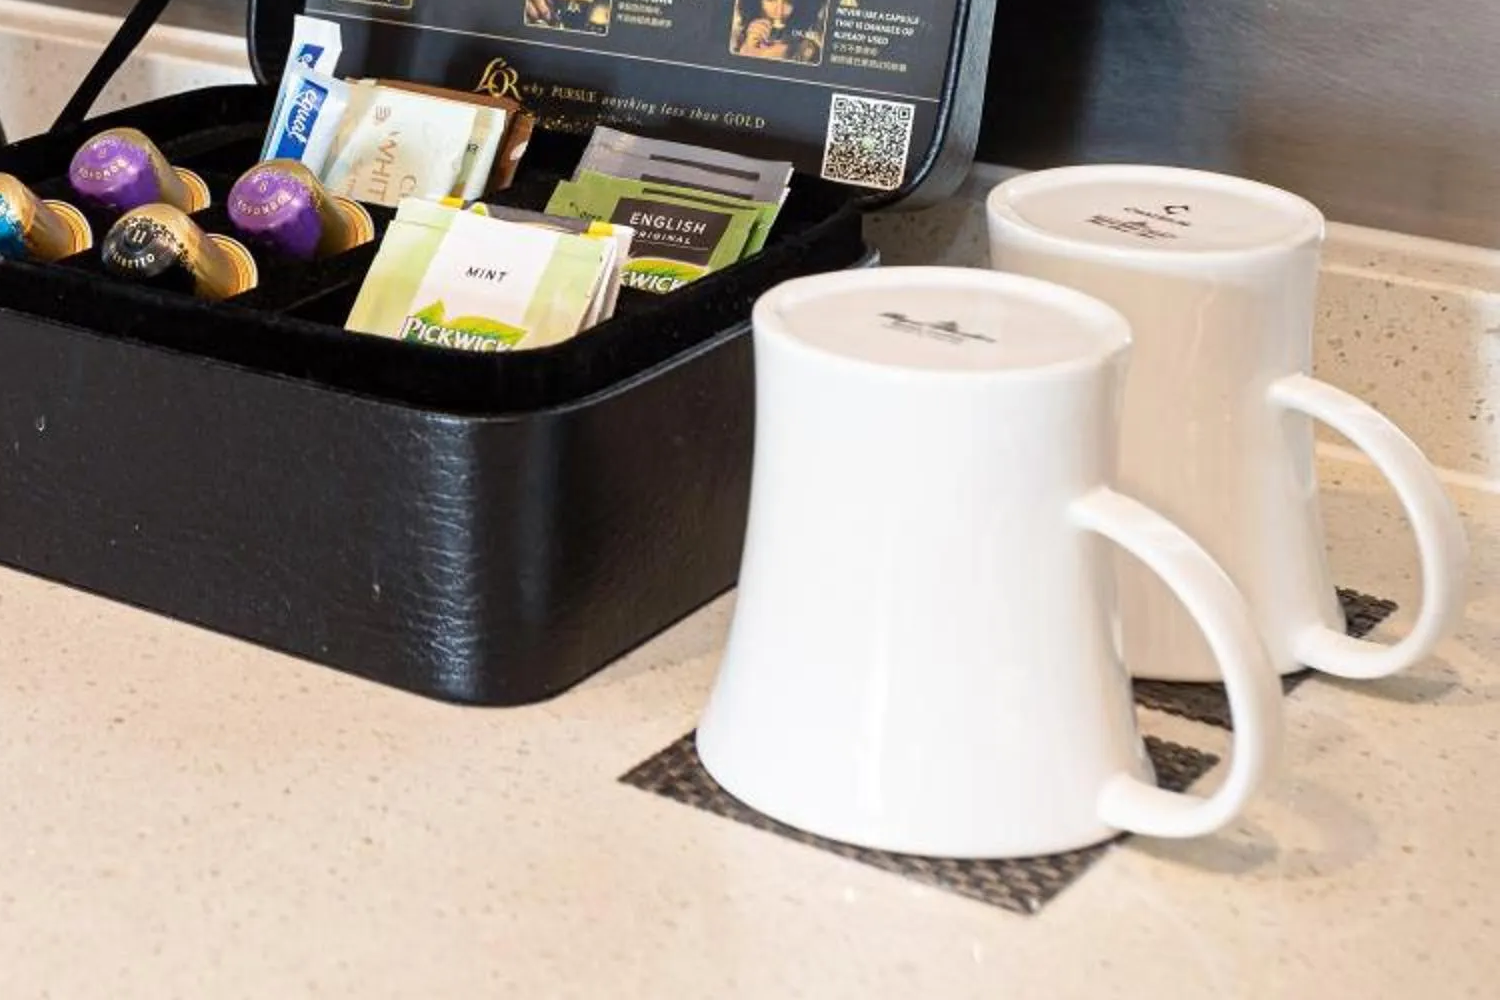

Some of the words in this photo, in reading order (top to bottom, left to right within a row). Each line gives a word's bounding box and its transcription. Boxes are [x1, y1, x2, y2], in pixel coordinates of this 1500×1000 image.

[551, 87, 597, 103] PURSUE
[601, 96, 656, 116] anything
[661, 102, 685, 118] less
[690, 107, 718, 121] than
[723, 111, 766, 129] GOLD
[367, 131, 401, 203] WHIT
[629, 211, 708, 235] ENGLISH
[132, 229, 147, 244] 11
[464, 265, 510, 283] MINT
